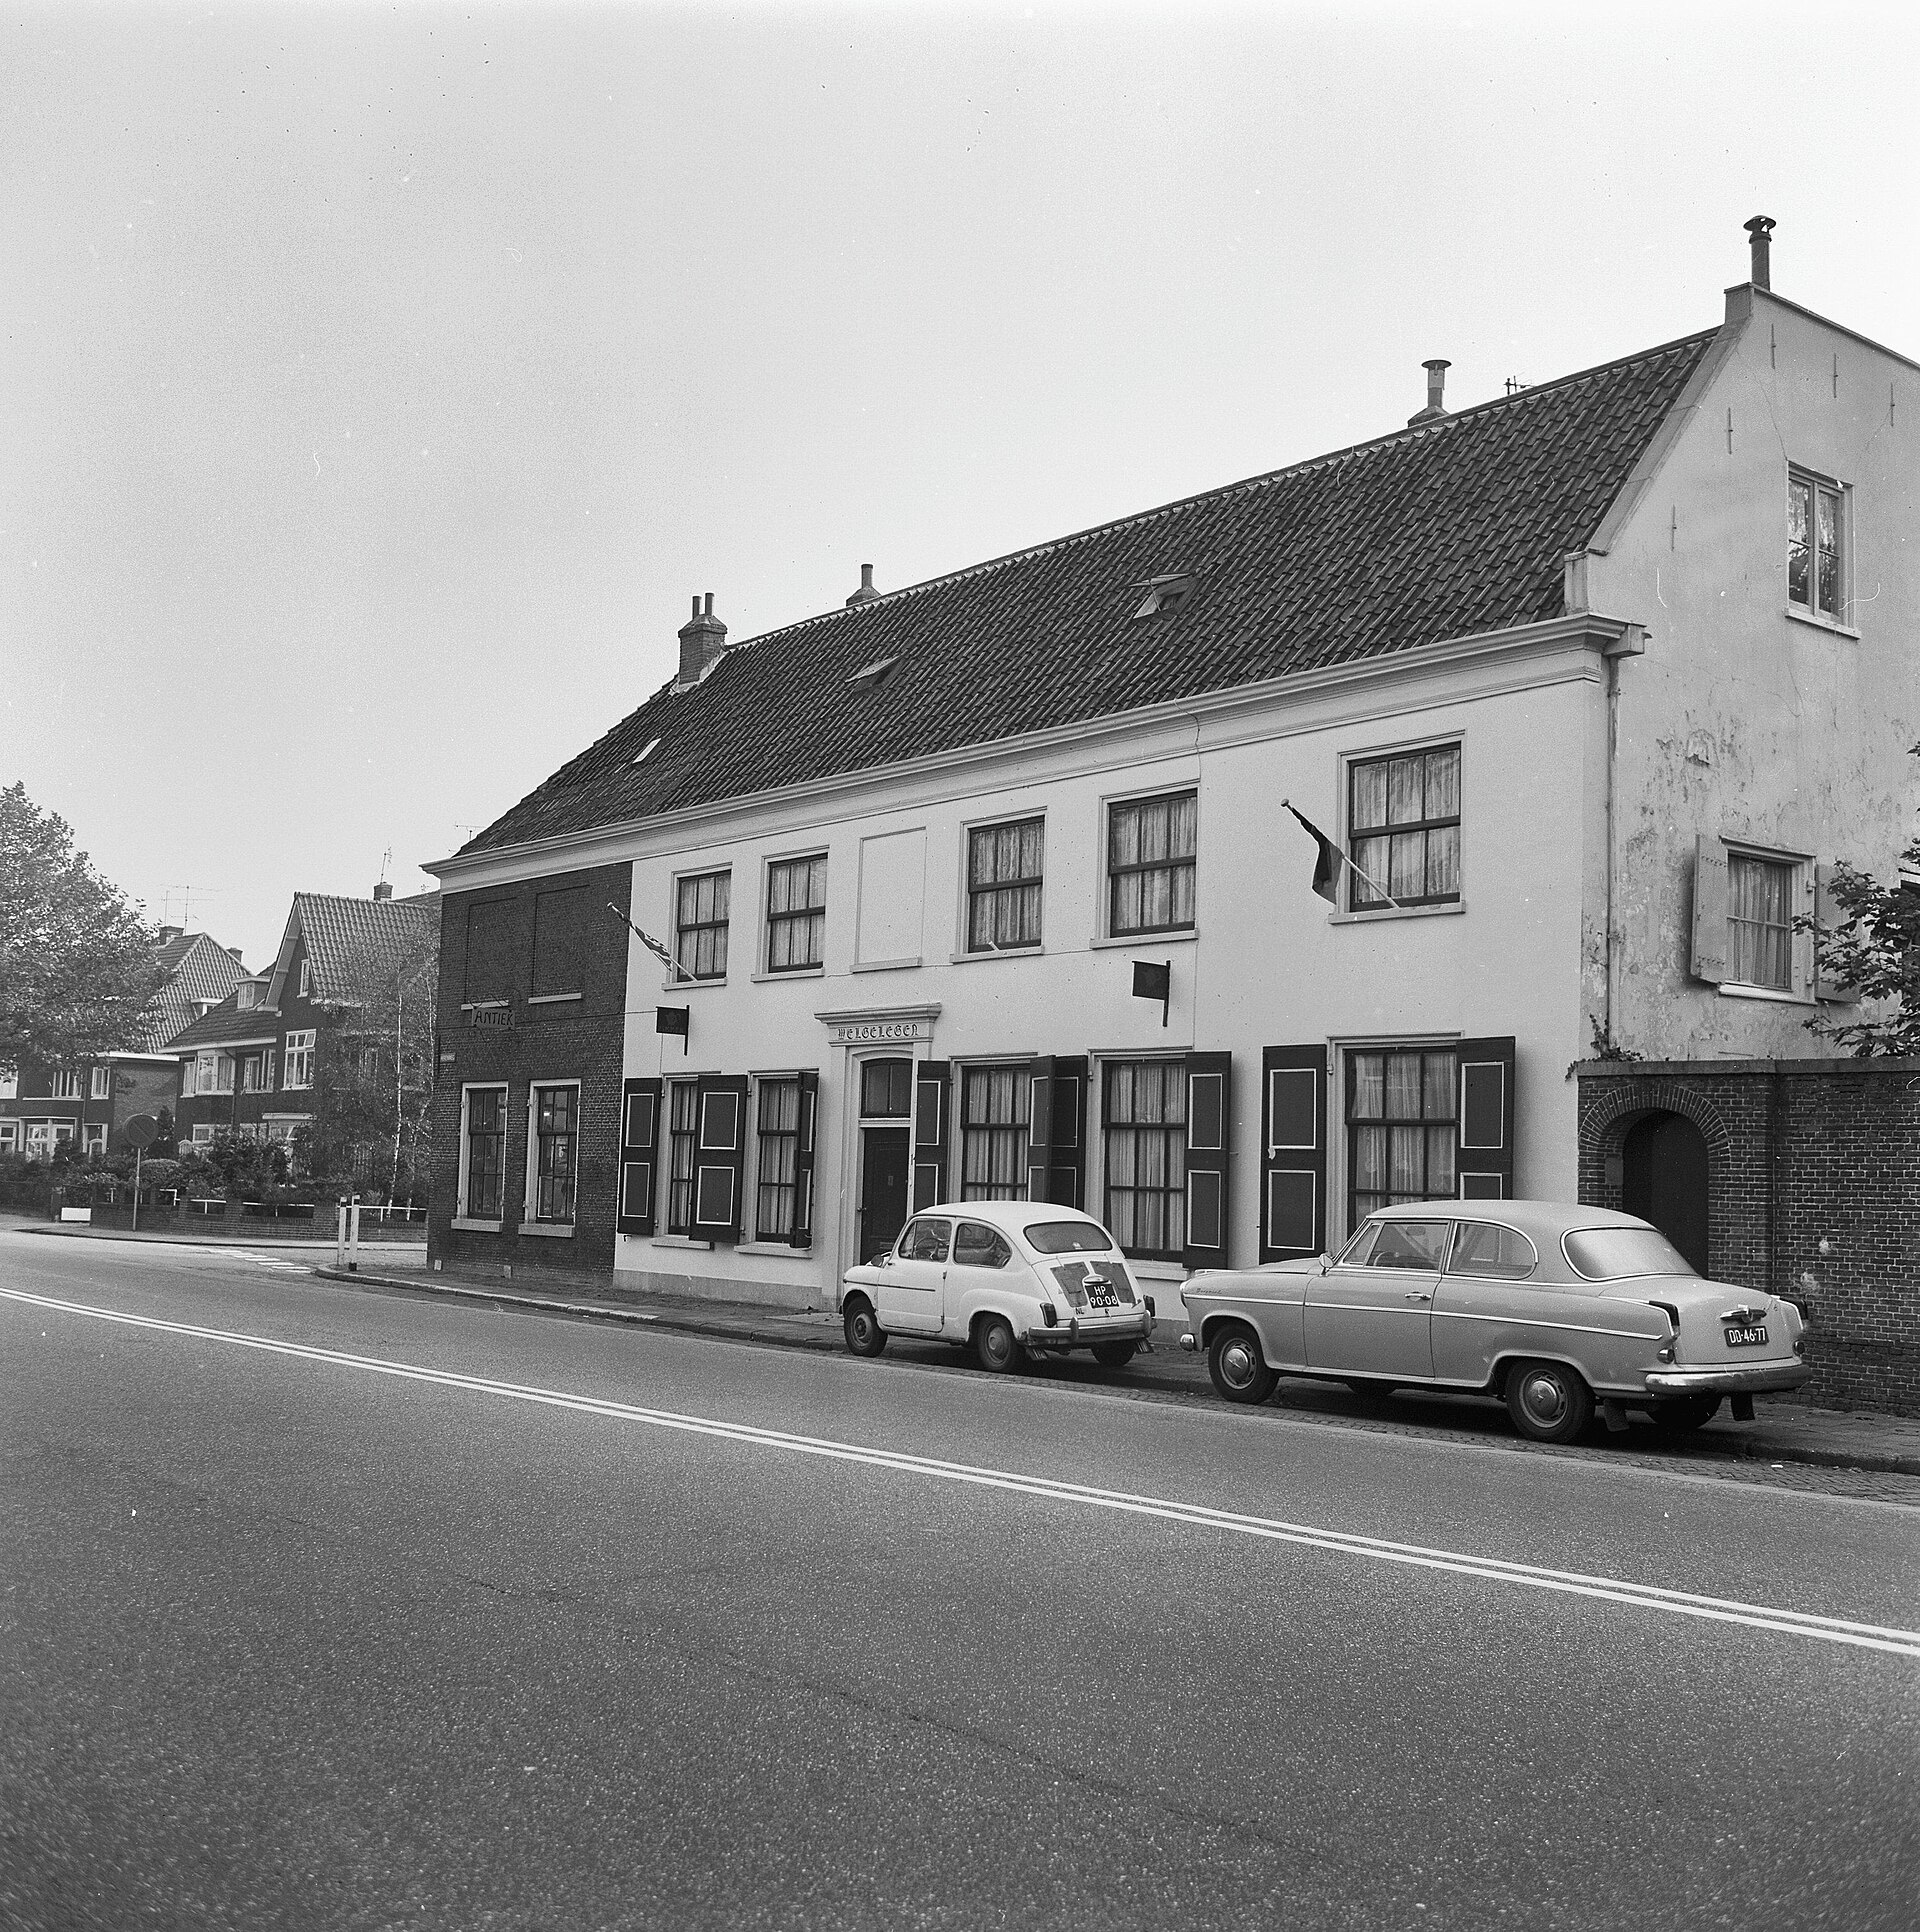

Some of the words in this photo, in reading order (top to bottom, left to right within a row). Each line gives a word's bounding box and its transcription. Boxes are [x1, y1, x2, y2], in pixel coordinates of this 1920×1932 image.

[474, 1010, 513, 1026] ANTIEK
[838, 1023, 919, 1040] WELGELEGEN
[1093, 1285, 1106, 1296] HP
